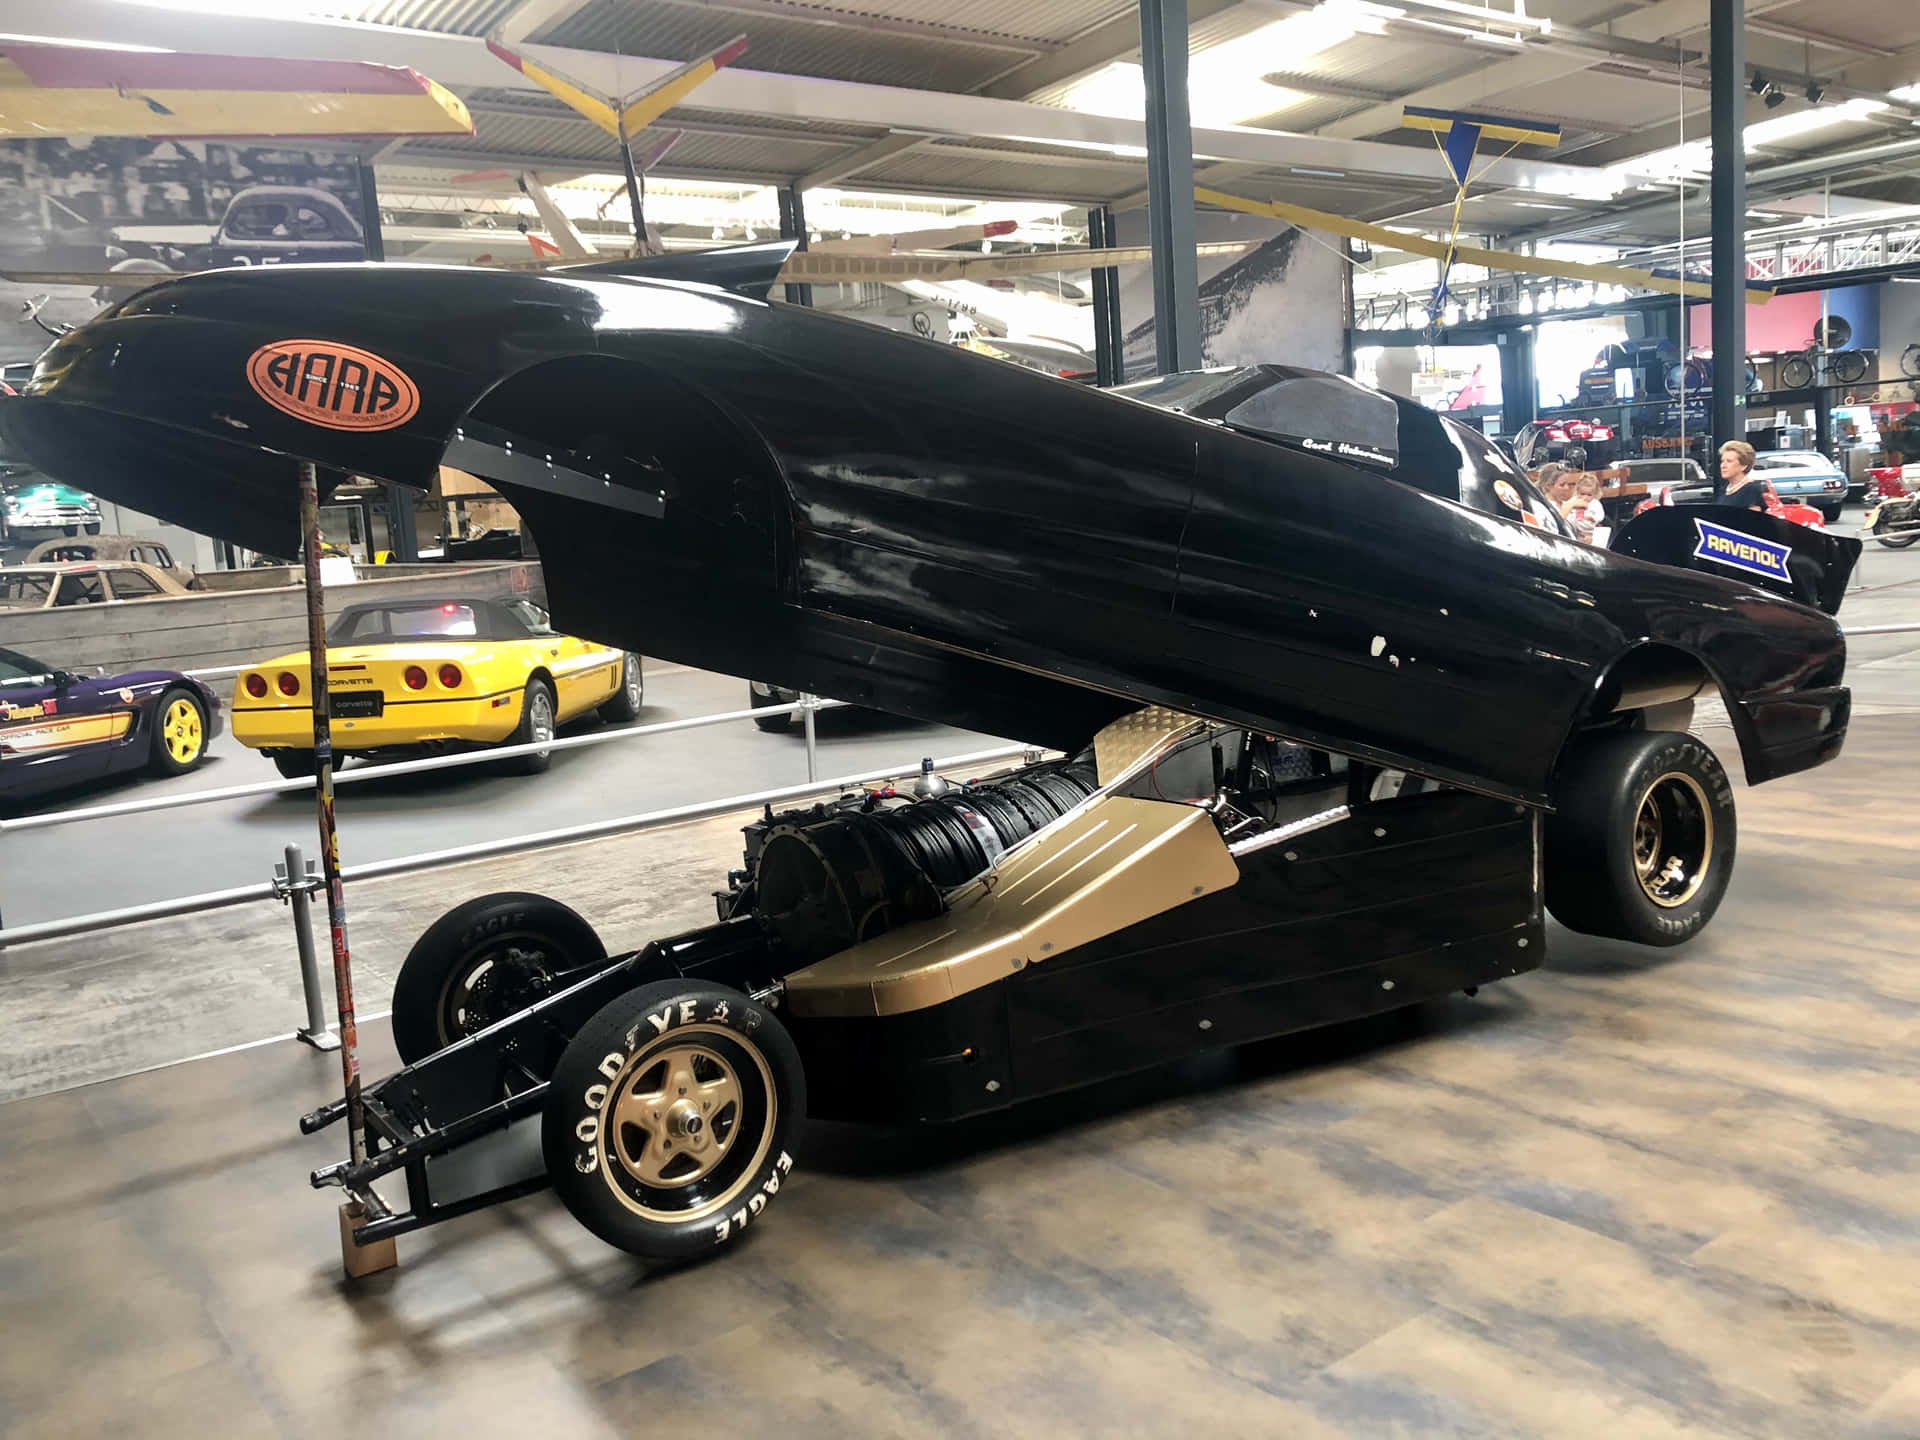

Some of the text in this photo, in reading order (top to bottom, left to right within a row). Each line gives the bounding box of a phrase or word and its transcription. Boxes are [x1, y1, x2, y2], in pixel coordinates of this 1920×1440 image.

[268, 352, 399, 414] HARA
[306, 373, 328, 383] SINCE
[1707, 534, 1780, 569] RAVENOL
[56, 725, 71, 733] CAR
[714, 1150, 794, 1245] EAGLE
